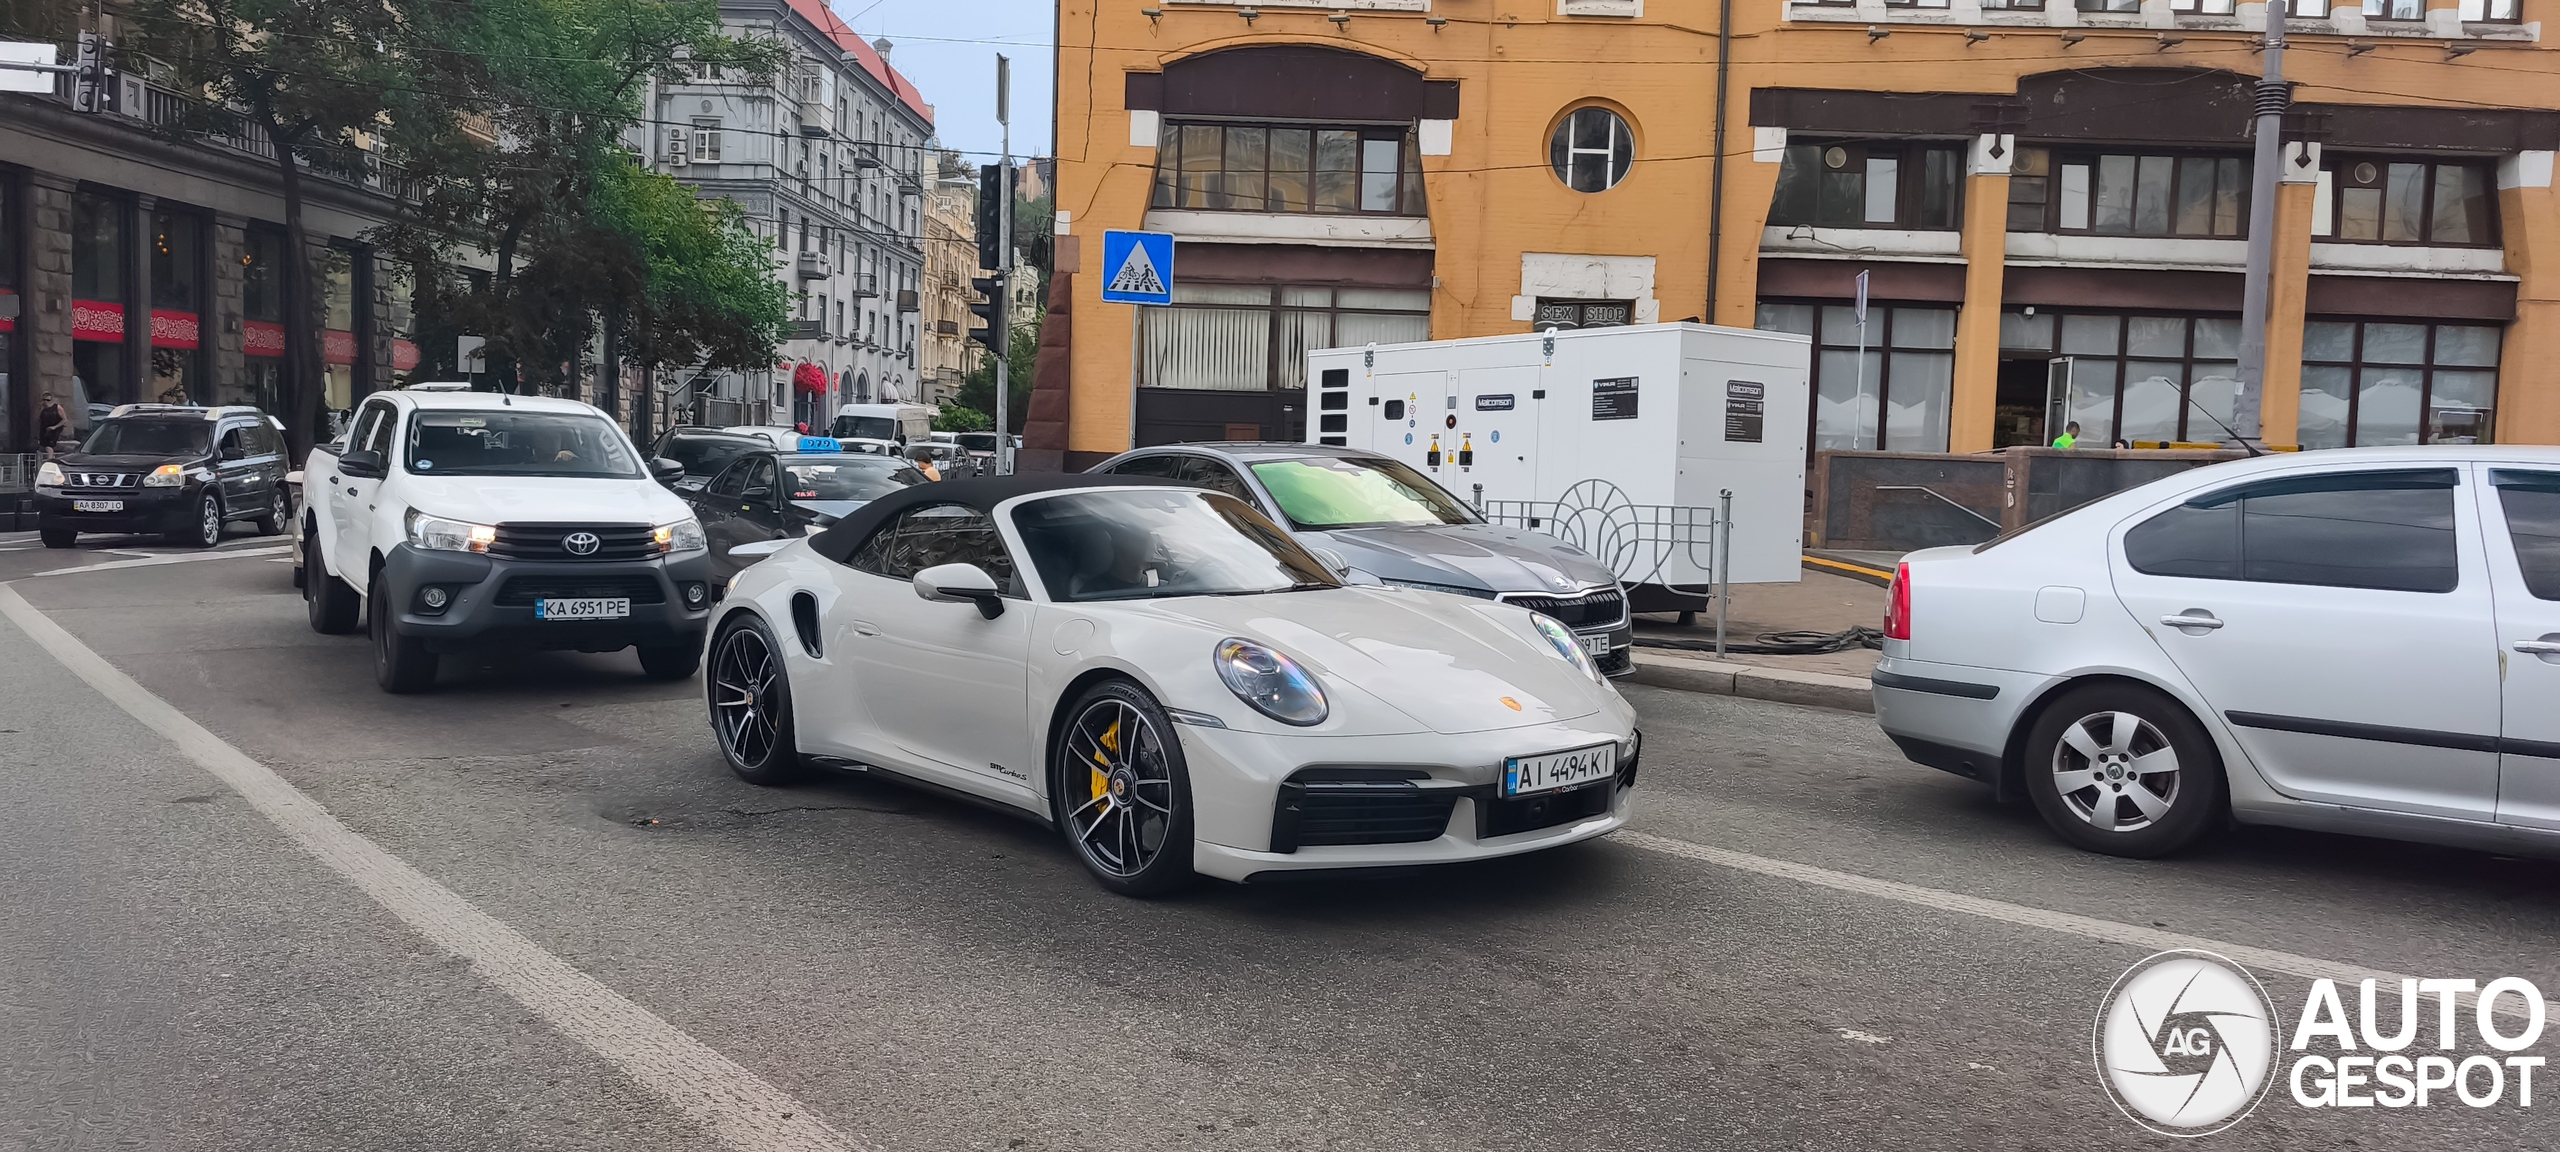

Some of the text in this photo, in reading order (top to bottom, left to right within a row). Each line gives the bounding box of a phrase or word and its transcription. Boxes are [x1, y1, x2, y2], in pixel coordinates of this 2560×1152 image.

[1541, 305, 1626, 322] SEX SHOP
[79, 501, 90, 509] AA
[90, 501, 109, 509] 8307
[545, 600, 627, 616] KA 6951 PE
[1592, 636, 1608, 652] TE
[1107, 686, 1138, 700] ZERO
[1519, 749, 1609, 789] AI 4494 KI
